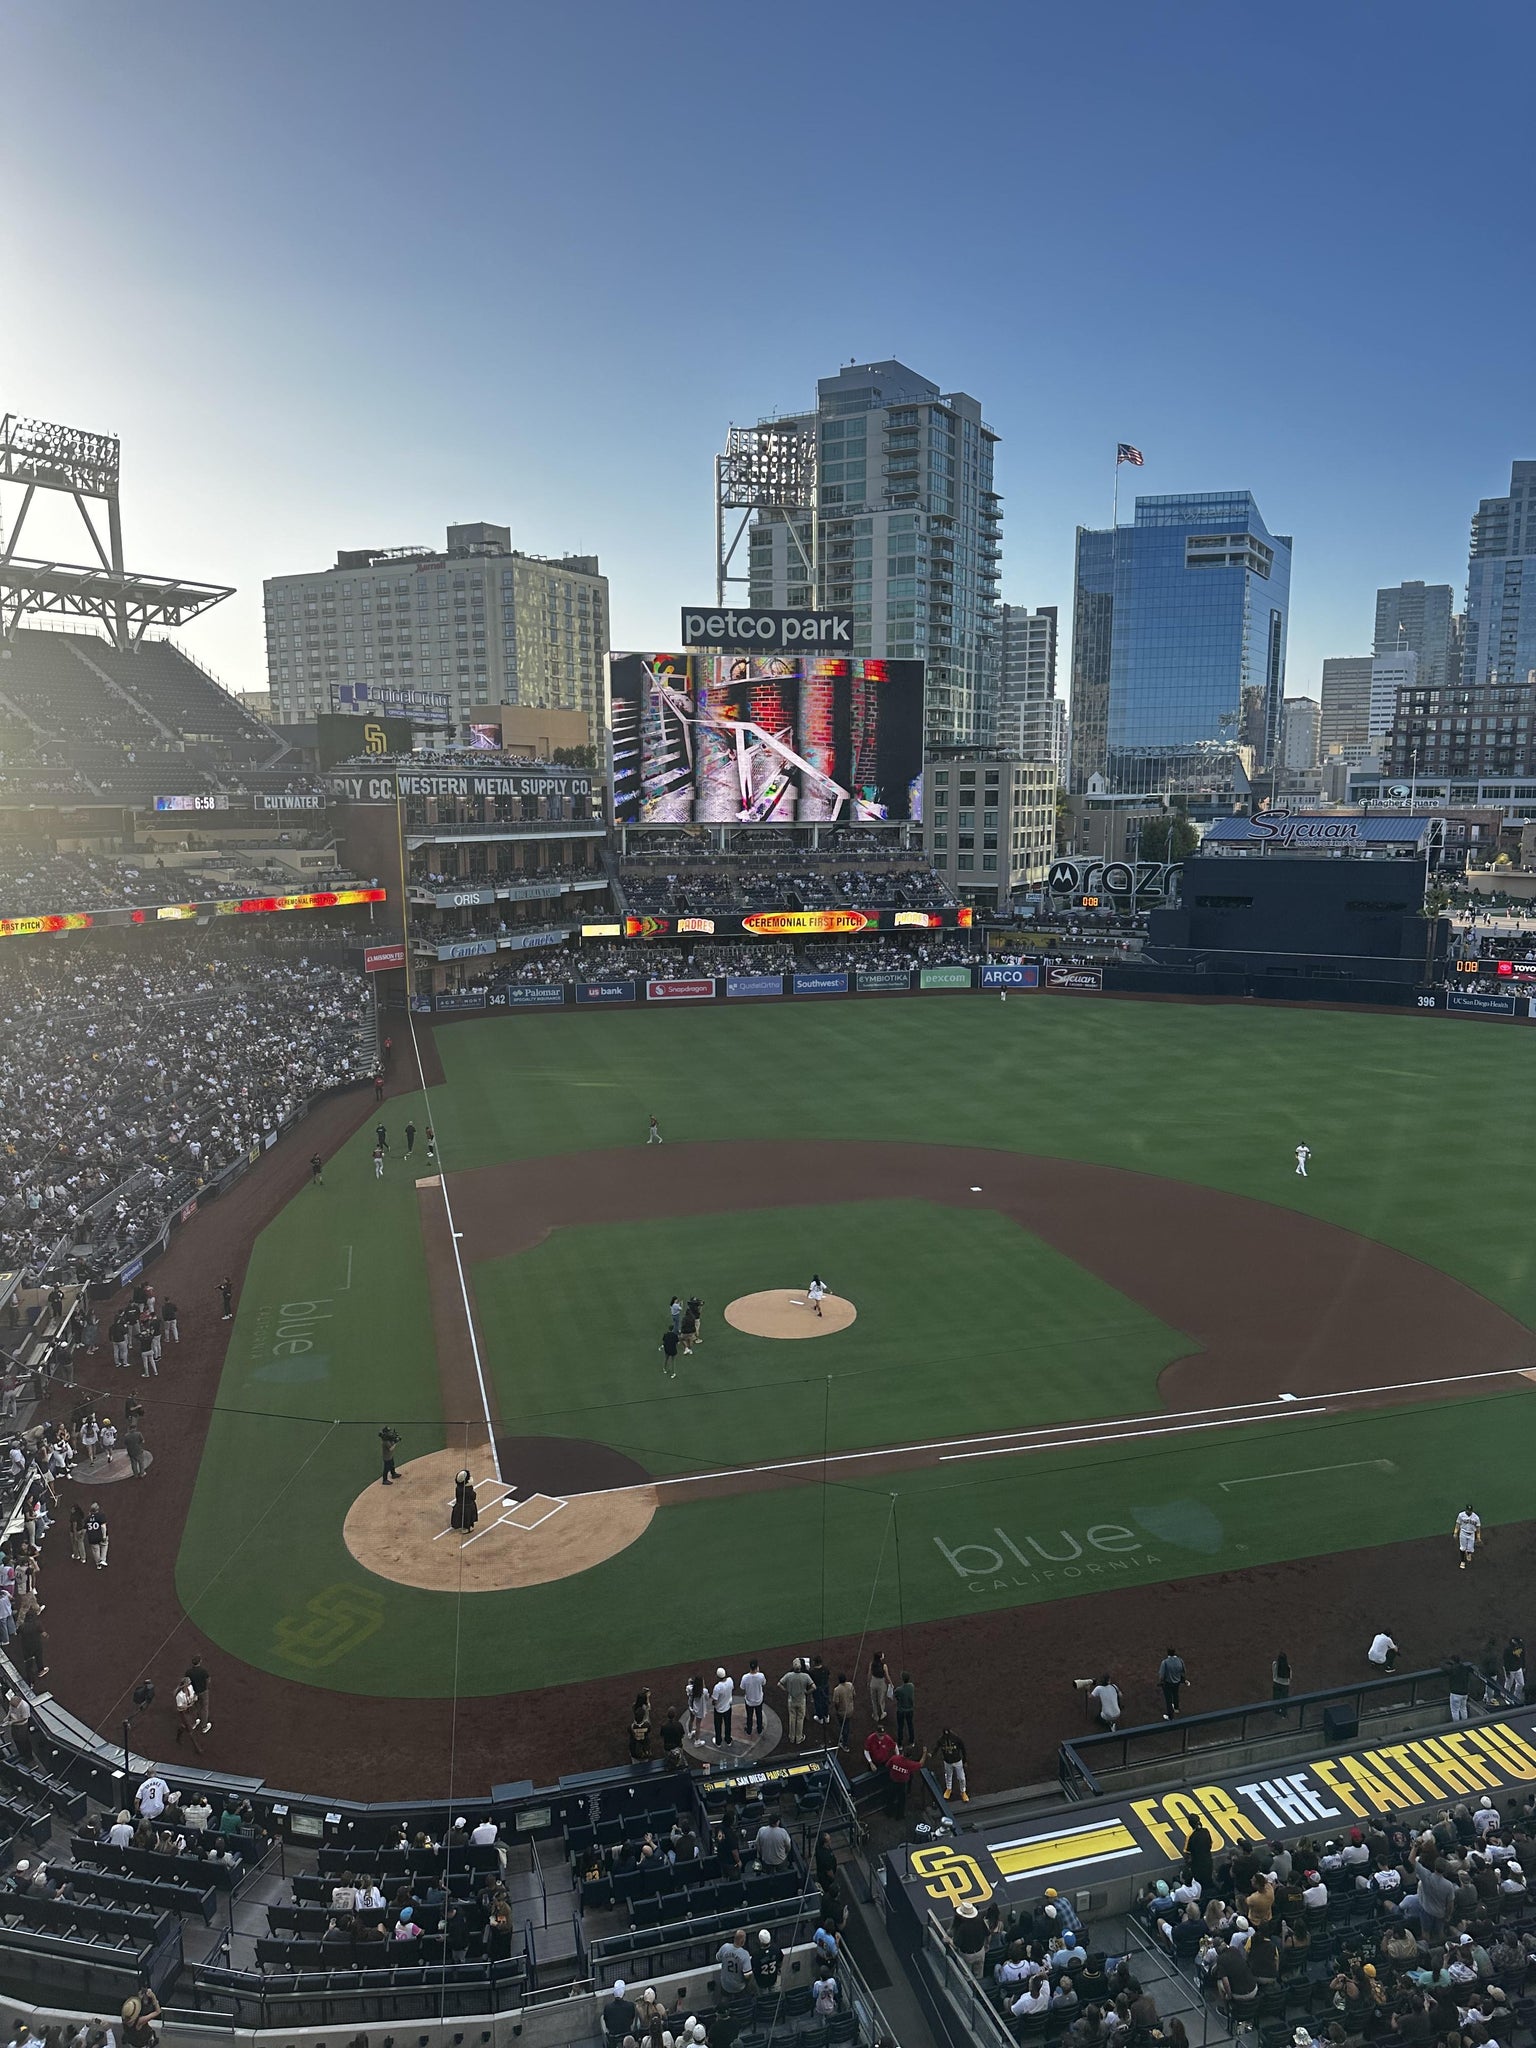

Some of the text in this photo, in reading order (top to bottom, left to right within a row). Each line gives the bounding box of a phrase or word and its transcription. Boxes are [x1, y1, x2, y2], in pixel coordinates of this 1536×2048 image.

[686, 611, 850, 646] petco park
[369, 778, 397, 800] CO.
[399, 776, 592, 796] WESTERN METAL SUPPLY CO.
[194, 796, 215, 810] 6:58
[263, 796, 319, 809] CUTWATER
[1358, 798, 1403, 809] Gallagher
[1246, 809, 1362, 847] Sycuan
[1083, 861, 1184, 895] razr
[454, 893, 480, 906] ORIS
[20, 920, 41, 931] PITCH
[678, 918, 715, 934] PADRES
[749, 917, 862, 928] CEREMONIAL FIRST PITCH
[372, 953, 395, 962] MISSION
[984, 971, 1023, 982] ARCO
[1051, 969, 1097, 986] Sycuan
[668, 985, 707, 994] Snapdragon
[797, 980, 839, 988] Southwest
[525, 988, 560, 997] Palomar
[601, 987, 623, 995] bank
[489, 995, 506, 1005] 342
[1417, 996, 1435, 1007] 396
[1463, 998, 1474, 1006] San
[1474, 999, 1490, 1009] Diego
[1490, 1001, 1509, 1009] Health
[272, 1299, 336, 1356] blue
[87, 1522, 100, 1531] 30
[933, 1524, 1143, 1577] blue
[968, 1553, 1162, 1593] CALIFORNIA
[736, 1775, 750, 1787] SAN
[748, 1772, 767, 1784] DIEGO
[149, 1787, 156, 1800] 3
[1129, 1785, 1266, 1861] FOR
[1234, 1772, 1342, 1829] THE
[727, 1960, 738, 1974] 21
[760, 1961, 777, 1975] 23
